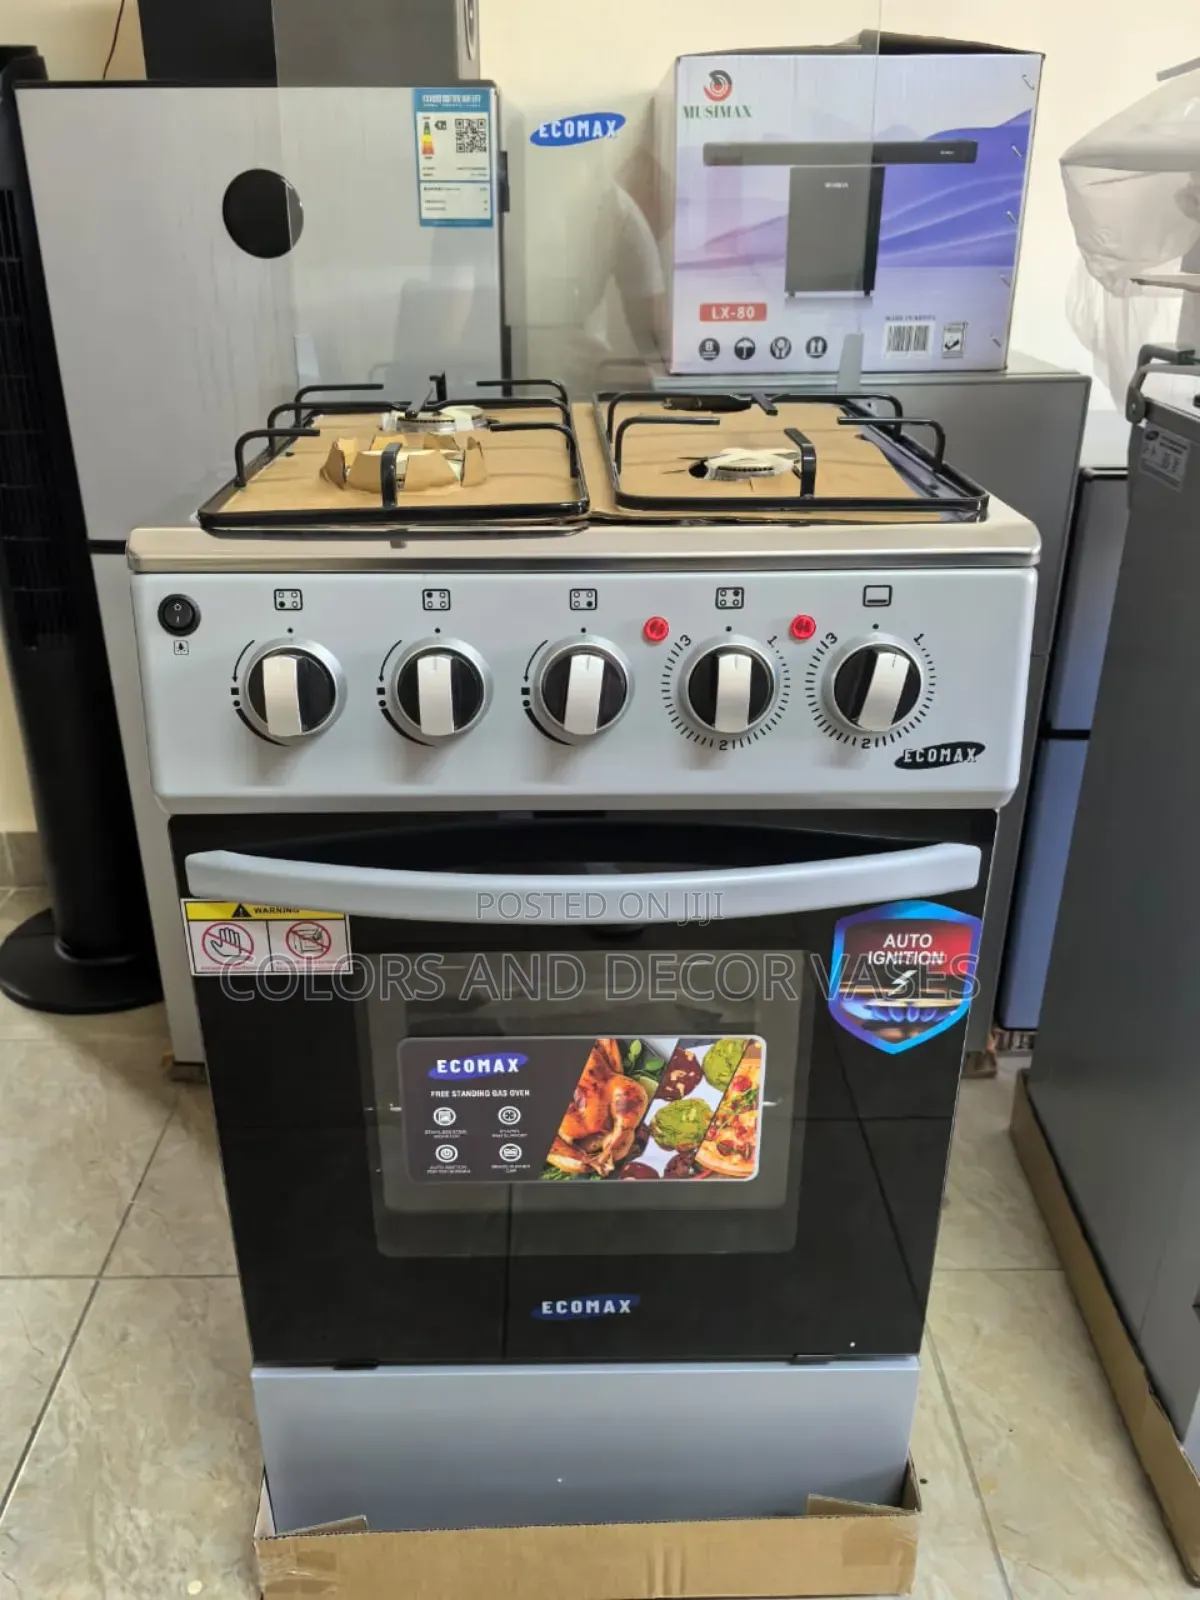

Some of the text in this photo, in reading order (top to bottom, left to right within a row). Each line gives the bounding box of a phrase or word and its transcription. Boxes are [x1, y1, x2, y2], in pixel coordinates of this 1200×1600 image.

[683, 104, 752, 119] MUSIMAX
[539, 119, 617, 138] ECOMAX
[711, 305, 756, 320] LX-80
[680, 634, 692, 647] 3
[825, 632, 838, 645] 3
[861, 738, 871, 749] 2
[904, 747, 977, 763] ECOMAX
[883, 933, 933, 949] AUTO
[867, 950, 944, 966] IGNITION
[436, 1058, 519, 1074] ECOMAX
[430, 1088, 531, 1099] FREE STANDING GAS OVEN
[541, 1299, 632, 1315] ECOMAX
